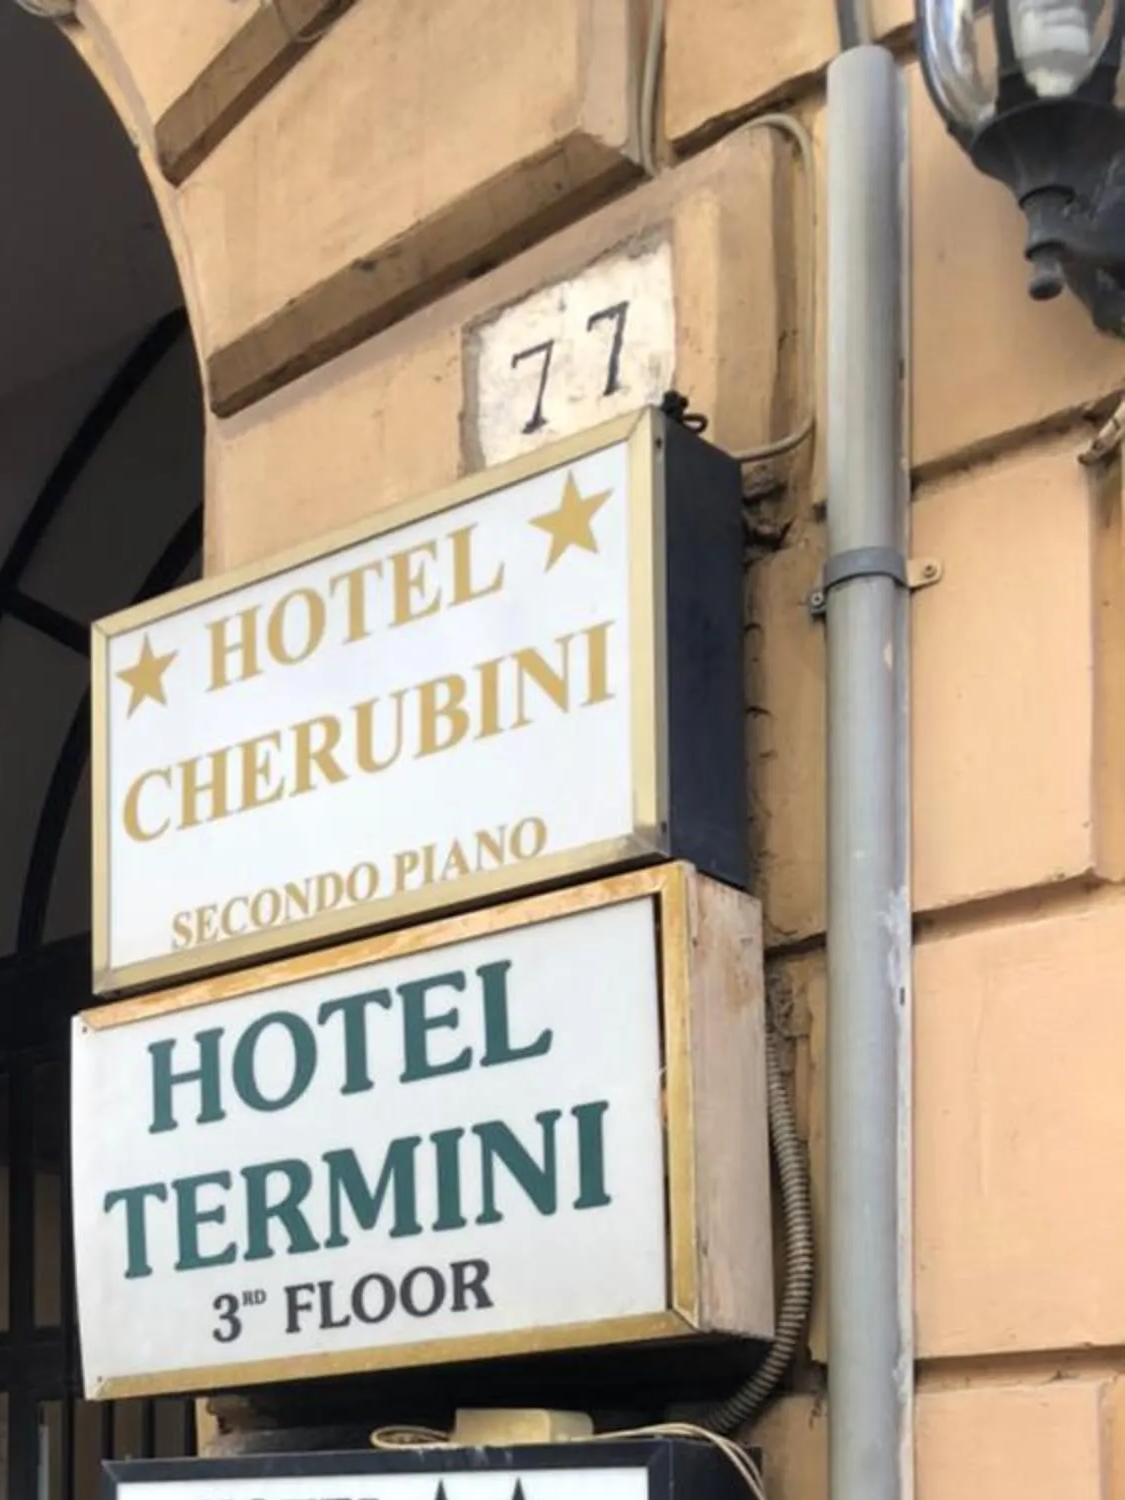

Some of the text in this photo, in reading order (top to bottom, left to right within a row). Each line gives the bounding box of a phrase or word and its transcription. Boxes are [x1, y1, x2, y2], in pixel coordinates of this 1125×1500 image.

[509, 300, 631, 435] 77
[204, 522, 506, 694] HOTEL
[121, 620, 618, 843] CHERUBINI
[170, 816, 549, 951] SECONDO PIANO
[147, 959, 553, 1135] HOTEL
[103, 1100, 613, 1281] TERMINI
[284, 1258, 495, 1334] FLOOR
